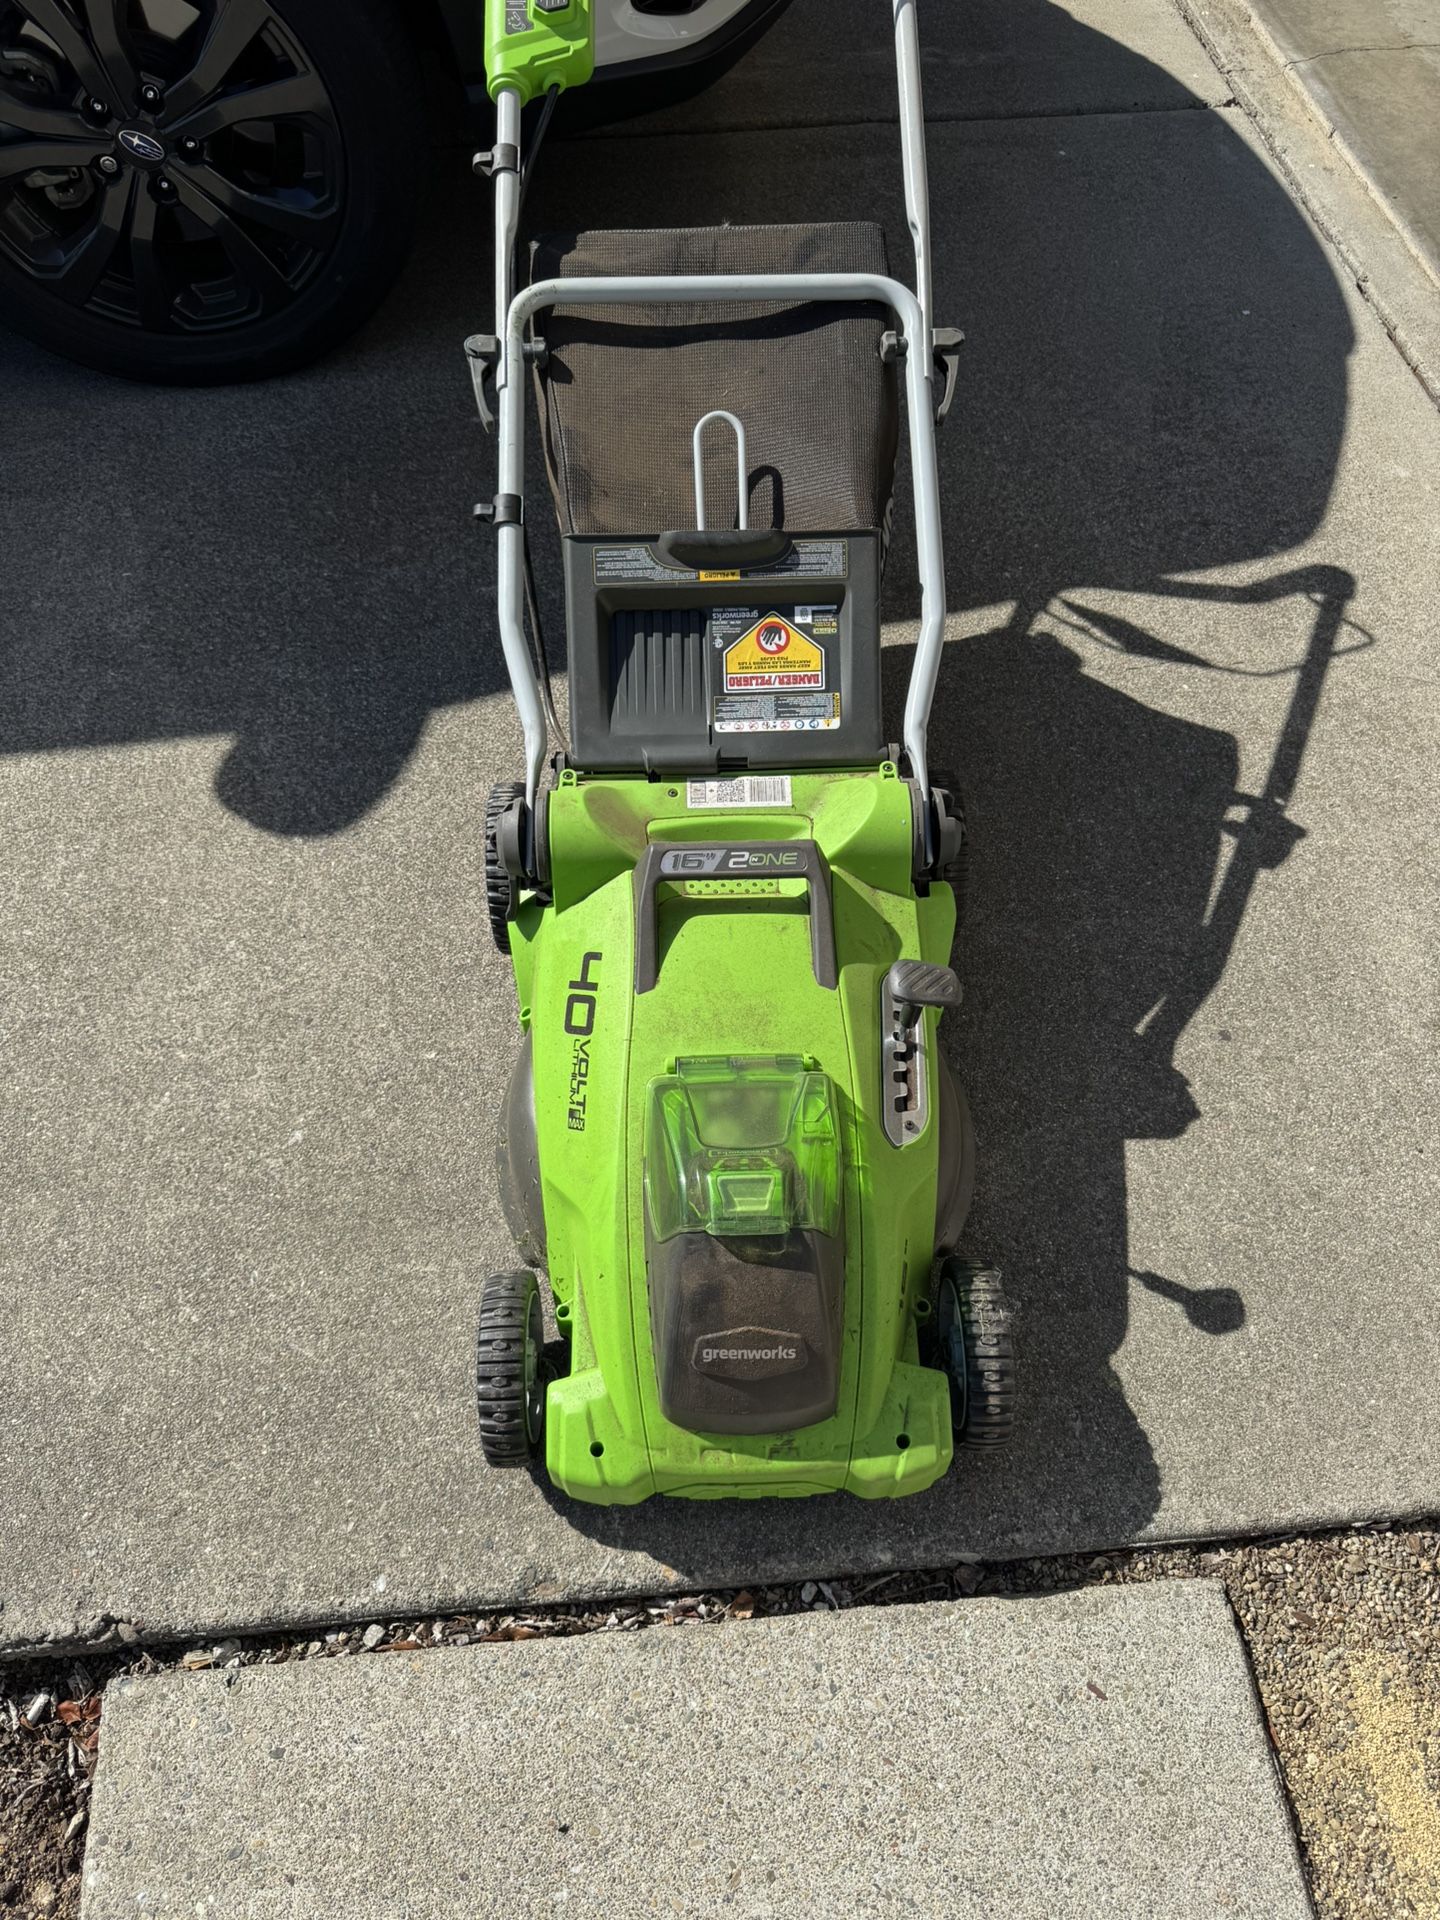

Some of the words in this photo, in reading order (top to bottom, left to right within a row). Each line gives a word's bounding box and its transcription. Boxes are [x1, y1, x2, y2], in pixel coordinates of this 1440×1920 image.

[712, 609, 758, 621] greenworks
[564, 951, 603, 1036] 40
[569, 1038, 581, 1105] LITHIUM
[576, 1039, 592, 1115] VOLT
[702, 1345, 797, 1362] greenworks
